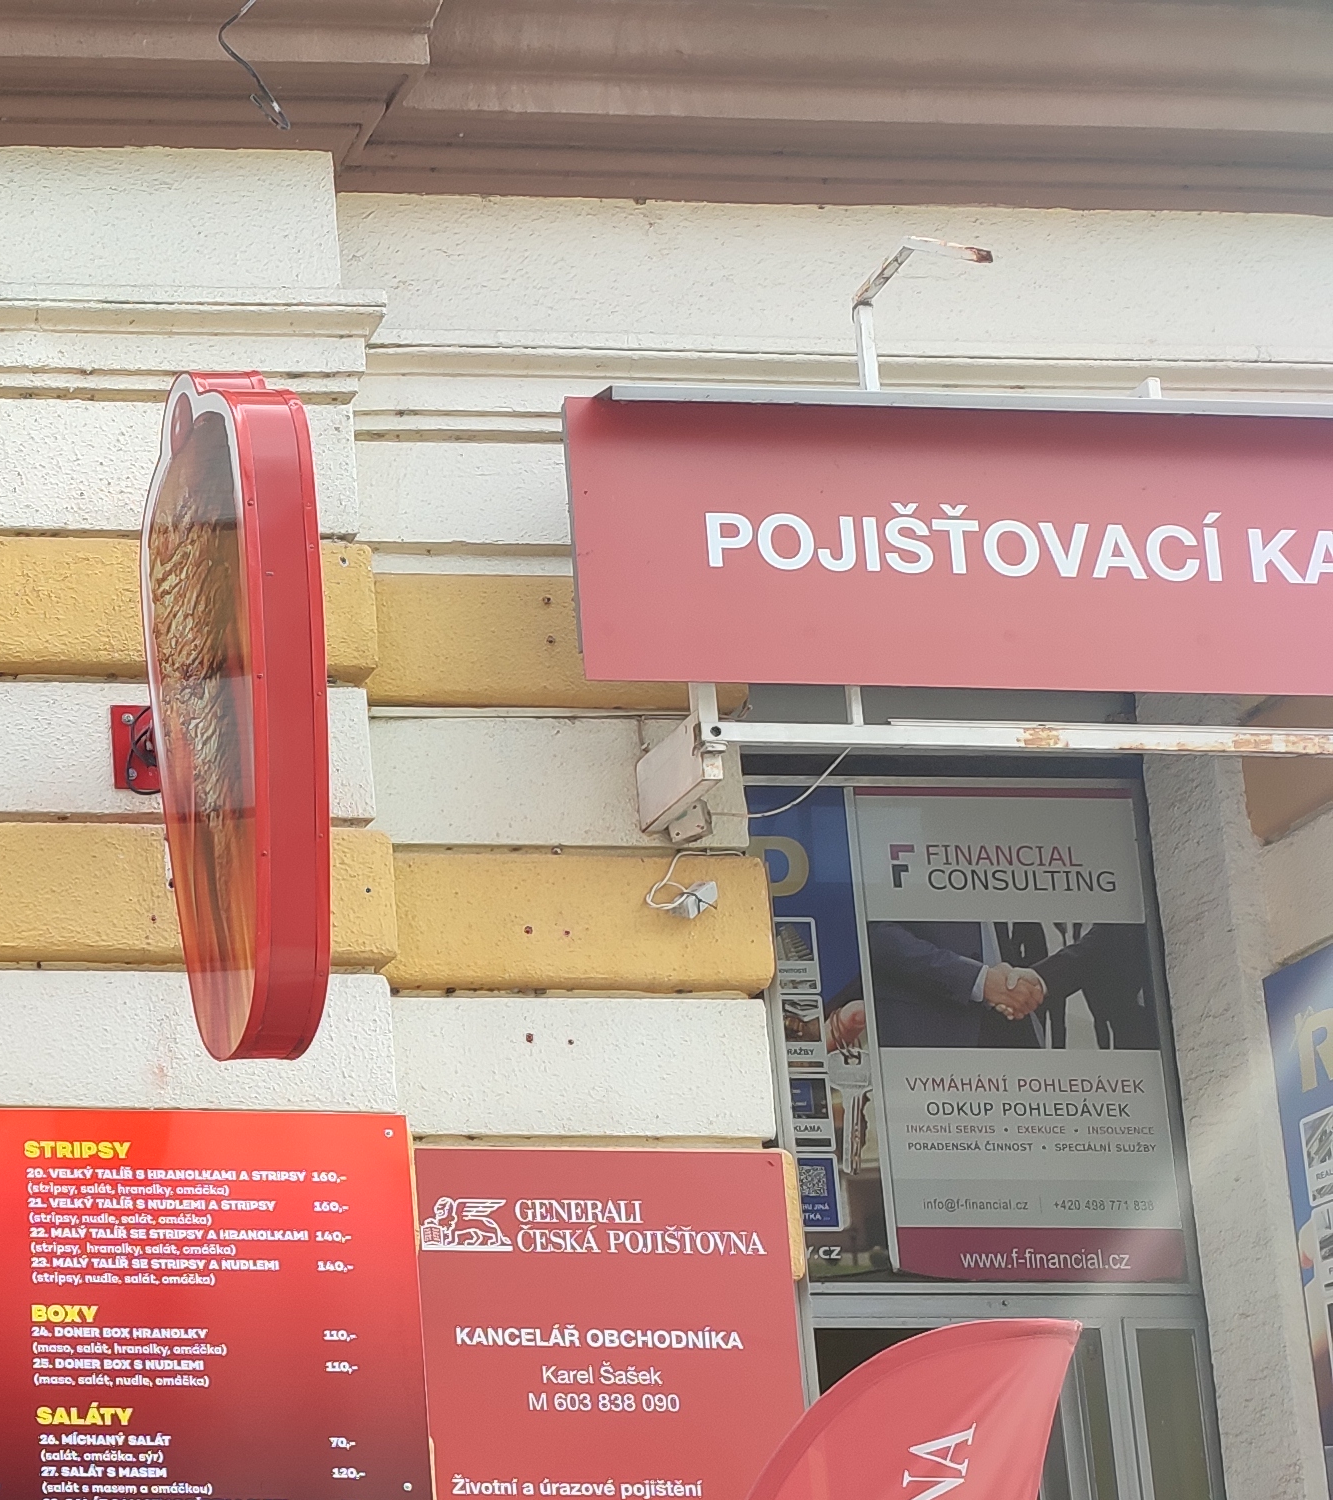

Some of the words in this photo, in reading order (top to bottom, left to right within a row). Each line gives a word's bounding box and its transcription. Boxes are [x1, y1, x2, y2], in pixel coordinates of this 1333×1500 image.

[706, 503, 1222, 581] POJIŠŤOVACÍ
[925, 845, 1084, 866] FINANCIAL
[927, 869, 1116, 892] CONSULTING
[905, 1074, 1009, 1092] VYMÁHÁNÍ
[1017, 1076, 1145, 1093] POHLEDÁVEK
[926, 1102, 994, 1116] ODKUP
[1001, 1099, 1131, 1117] POHLEDÁVEK
[905, 1123, 952, 1133] INKASNÍ
[955, 1125, 996, 1133] SERVIS
[1017, 1126, 1066, 1134] EXEKUCE
[24, 1141, 131, 1158] STRIPSY
[907, 1141, 982, 1150] PORADENSKÁ
[984, 1141, 1034, 1151] ČINNOST
[1054, 1141, 1112, 1152] SPECIÁLNÍ
[1115, 1142, 1157, 1152] SLUŽBY
[514, 1200, 644, 1223] GENERALI
[1053, 1200, 1081, 1210] +420
[516, 1225, 602, 1252] ČESKÁ
[606, 1226, 768, 1255] POJIŠŤOVNA
[31, 1305, 99, 1322] BOXY
[455, 1324, 582, 1347] KANCELÁŘ
[586, 1327, 744, 1349] OBCHODNÍKA
[32, 1358, 54, 1368] 25.
[54, 1359, 102, 1369] DONER
[103, 1359, 132, 1369] BOX
[133, 1360, 144, 1369] S
[145, 1360, 205, 1370] NUDLEMI
[542, 1365, 595, 1383] Karel
[598, 1362, 663, 1386] Šašek
[528, 1393, 548, 1410] M
[554, 1393, 592, 1410] 603
[598, 1394, 636, 1411] 838
[641, 1394, 680, 1411] 090
[35, 1402, 133, 1425] SALÁTY
[38, 1435, 60, 1444] 26.
[61, 1432, 126, 1445] MÍCHANÝ
[127, 1433, 172, 1446] SALÁT
[451, 1474, 518, 1495] Životní
[521, 1483, 535, 1495] a
[539, 1478, 616, 1495] úrazové
[620, 1480, 703, 1499] pojištění
